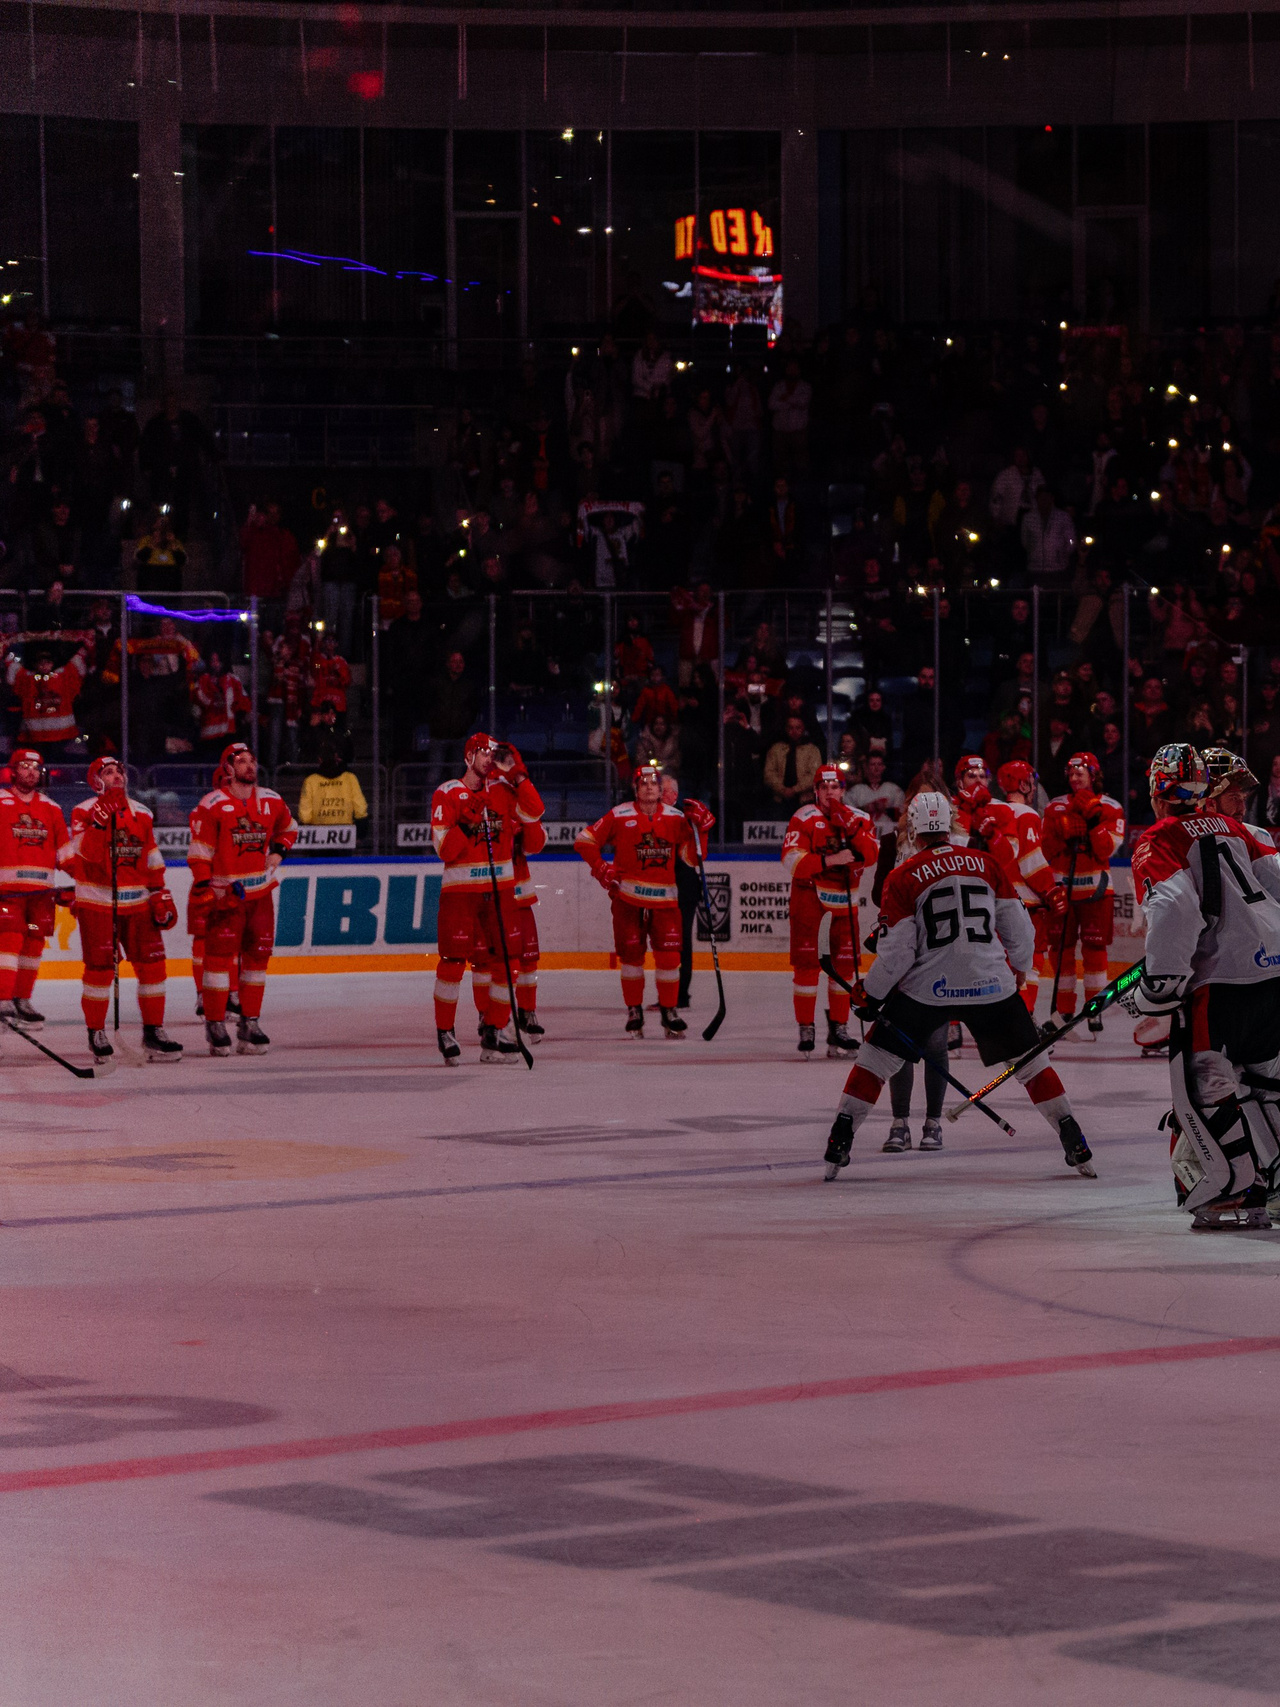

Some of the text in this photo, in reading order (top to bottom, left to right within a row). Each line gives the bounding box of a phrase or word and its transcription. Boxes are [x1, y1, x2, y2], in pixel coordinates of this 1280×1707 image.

[928, 820, 940, 831] 65
[1181, 817, 1231, 839] BERDIN
[747, 825, 784, 840] KHL.
[784, 831, 800, 848] 32
[911, 855, 985, 884] YAKUPOV
[740, 882, 790, 892] ФОНБЕТ
[1062, 876, 1094, 886] SBUR
[634, 885, 666, 897] SIBUR
[819, 892, 850, 904] SIBU
[275, 874, 443, 947] IBU
[922, 884, 993, 950] 65
[740, 923, 773, 934] ЛИГА
